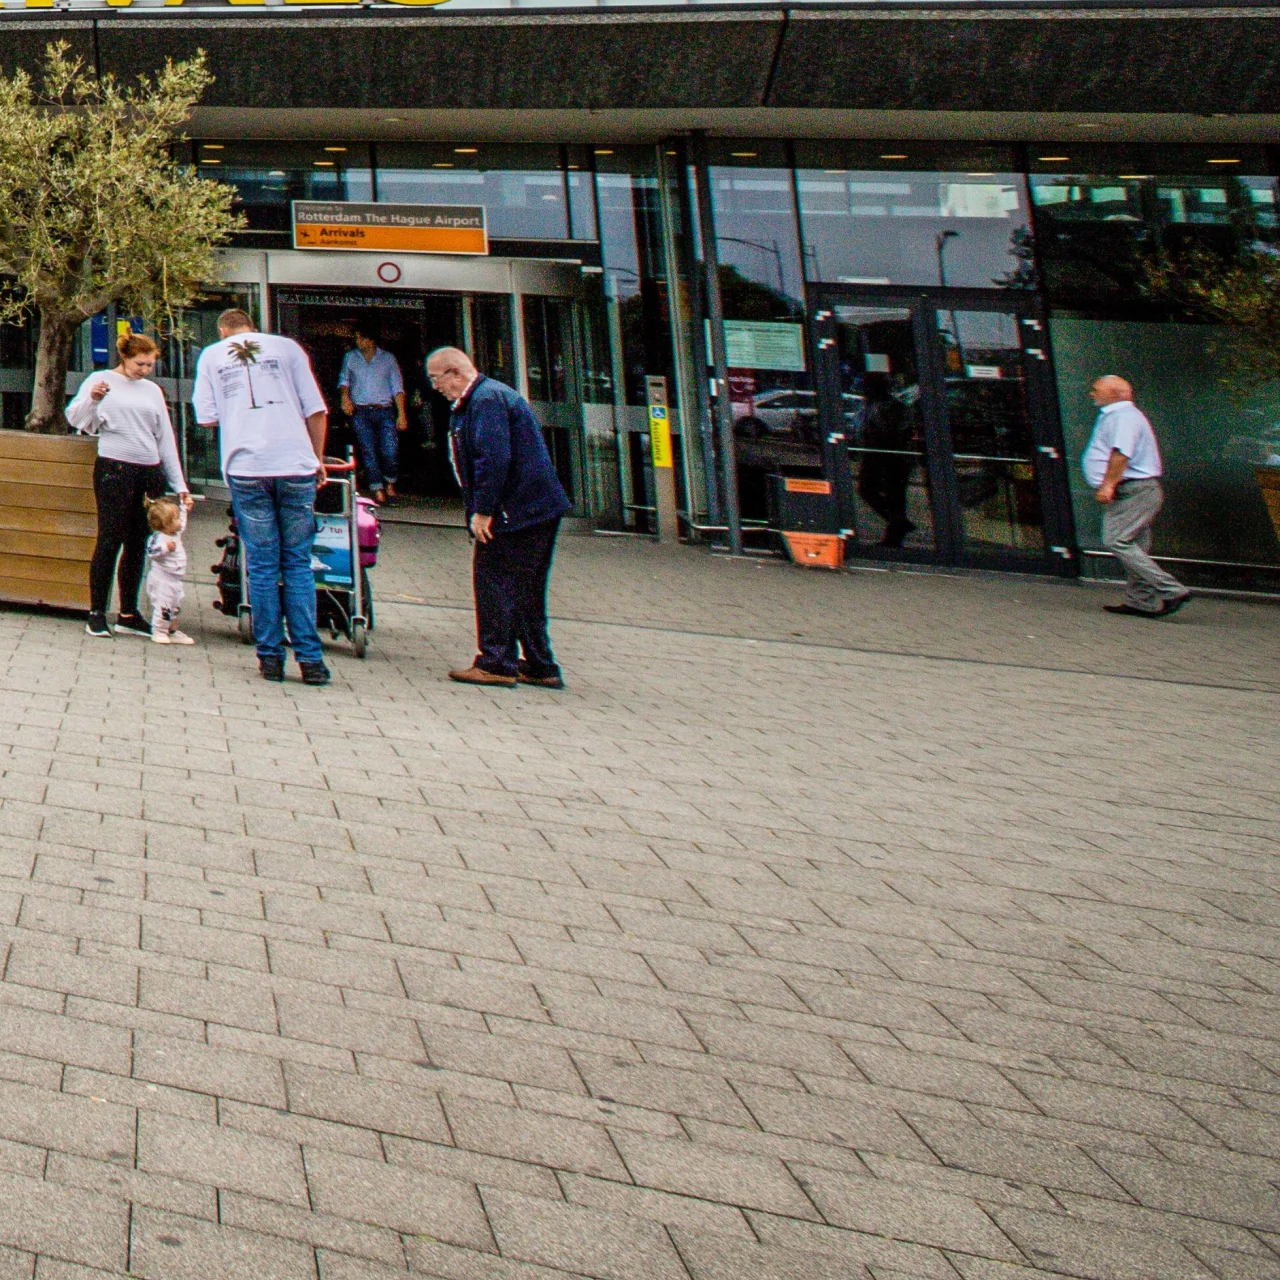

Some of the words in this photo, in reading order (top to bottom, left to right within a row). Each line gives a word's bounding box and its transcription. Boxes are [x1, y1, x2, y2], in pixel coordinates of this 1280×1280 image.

[297, 211, 361, 223] Rotterdam
[364, 212, 388, 224] The
[391, 213, 431, 227] Hague
[434, 214, 481, 227] Airport
[319, 227, 366, 238] Arrivals
